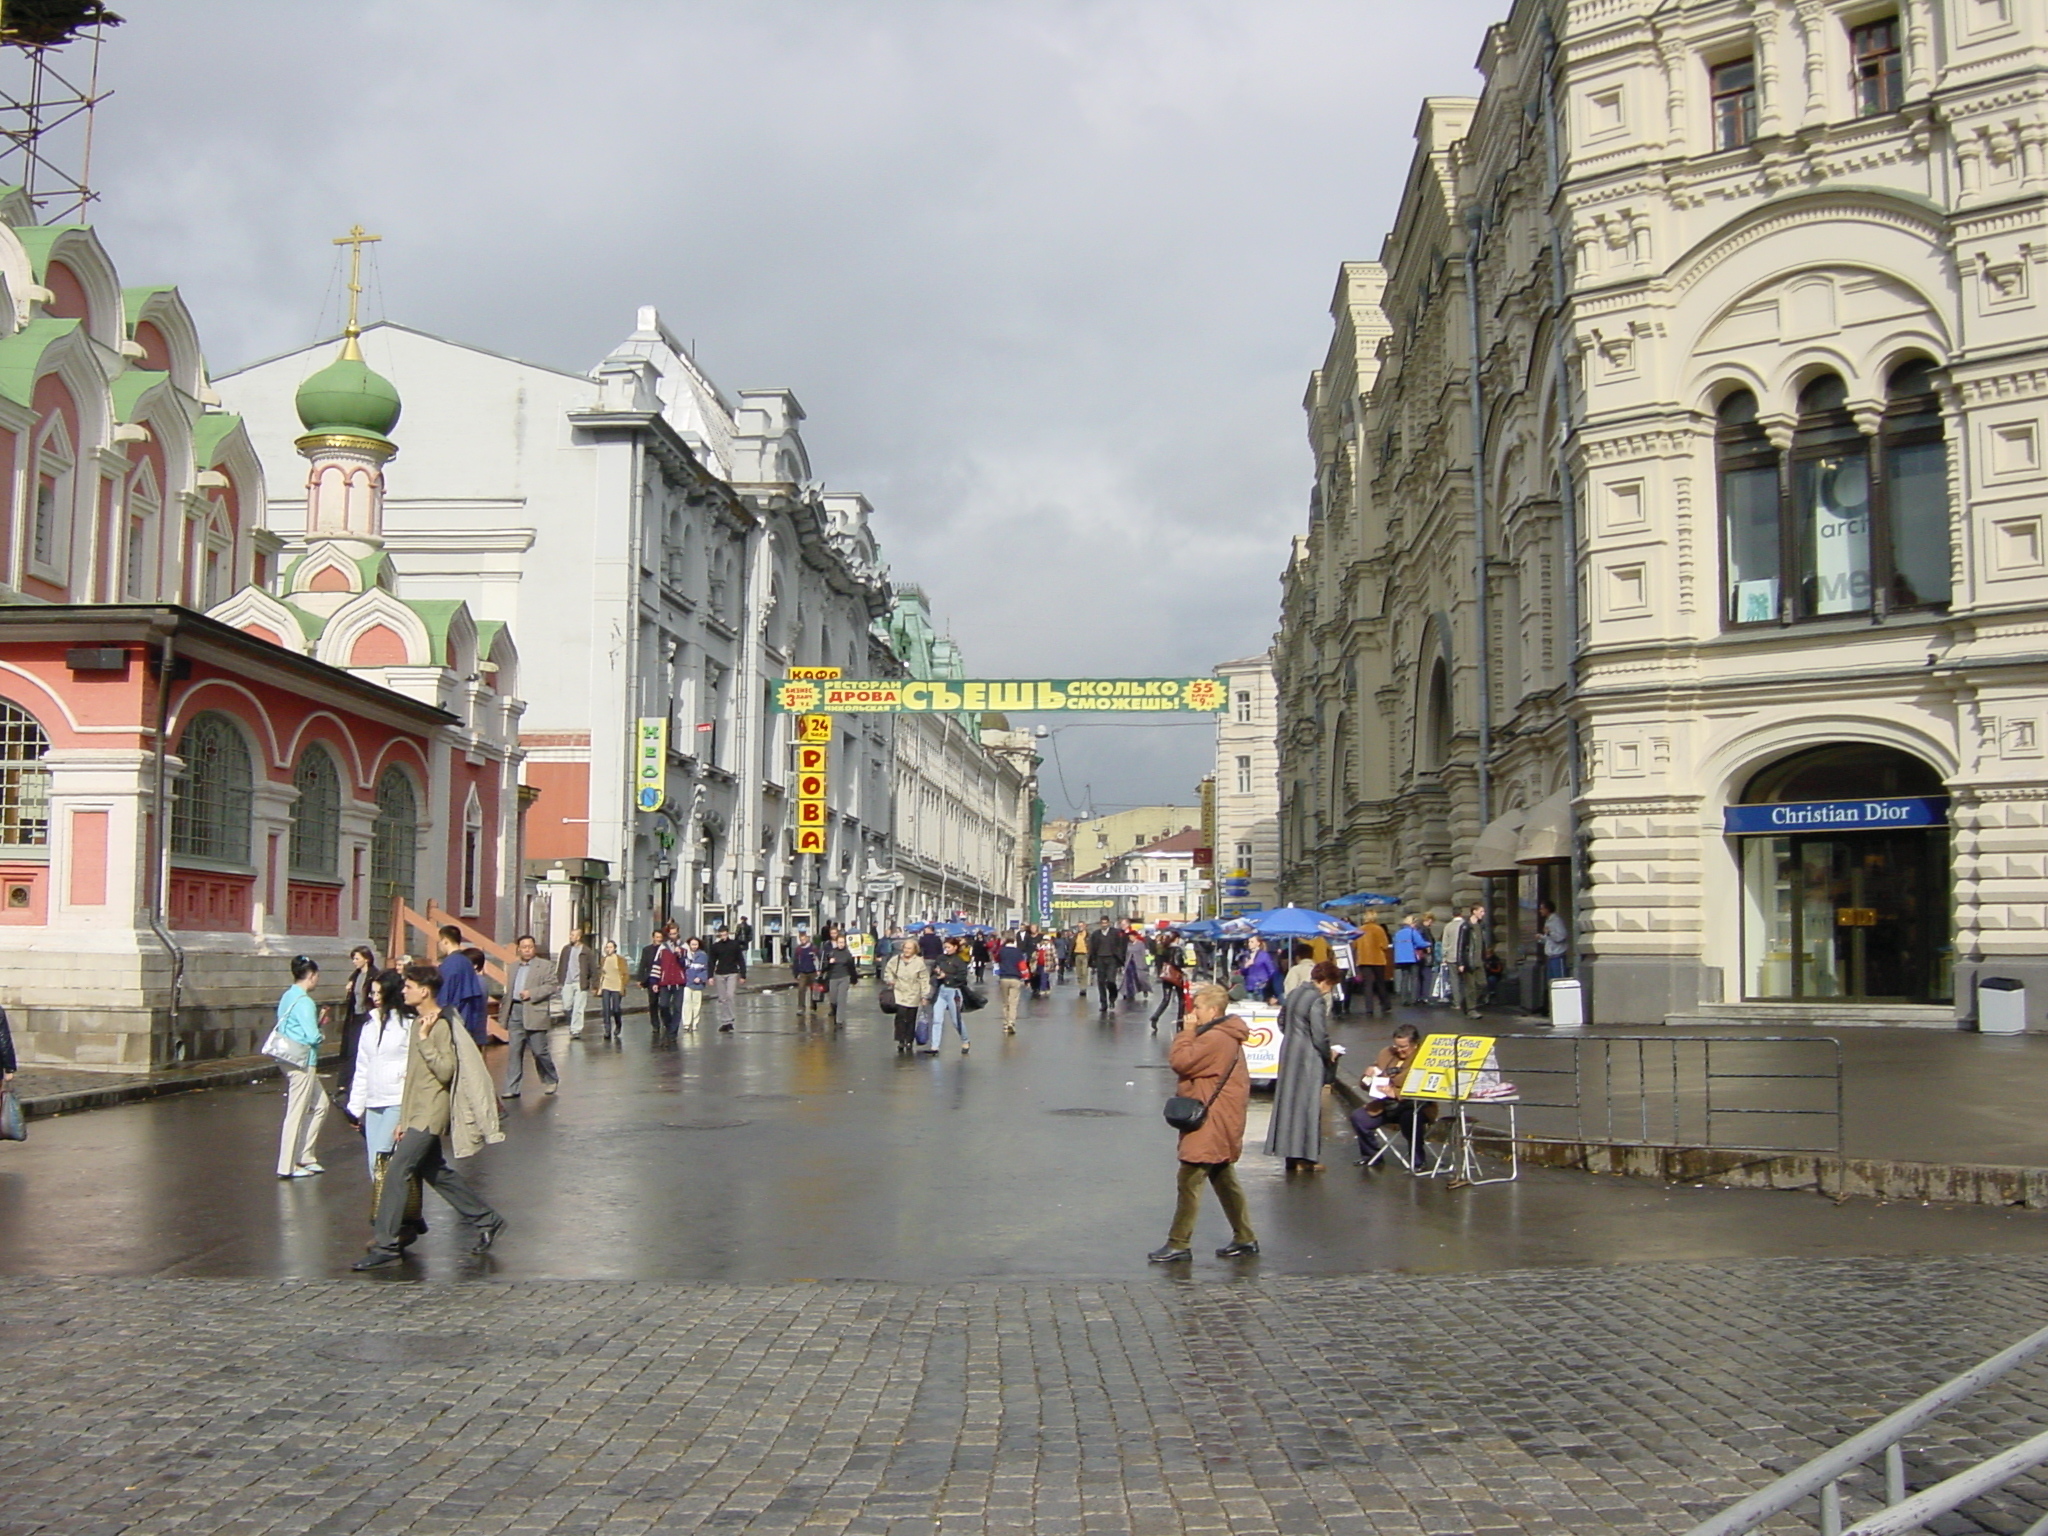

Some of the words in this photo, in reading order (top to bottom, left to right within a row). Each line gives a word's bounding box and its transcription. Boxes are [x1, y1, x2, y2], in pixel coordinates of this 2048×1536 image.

[824, 681, 901, 690] РЕСТОРАН
[1067, 681, 1179, 696] СКОЛЬКО
[1192, 683, 1213, 693] 55
[786, 694, 795, 707] 3
[829, 691, 896, 704] ДРОВА
[901, 681, 1067, 711] СЪЕШЬ
[1199, 698, 1205, 706] 9
[1066, 697, 1180, 710] СМОЖЕШЬ!
[811, 719, 829, 732] 24
[1772, 805, 1859, 824] Christian
[1865, 802, 1910, 821] Dior
[1096, 884, 1139, 894] GENERO
